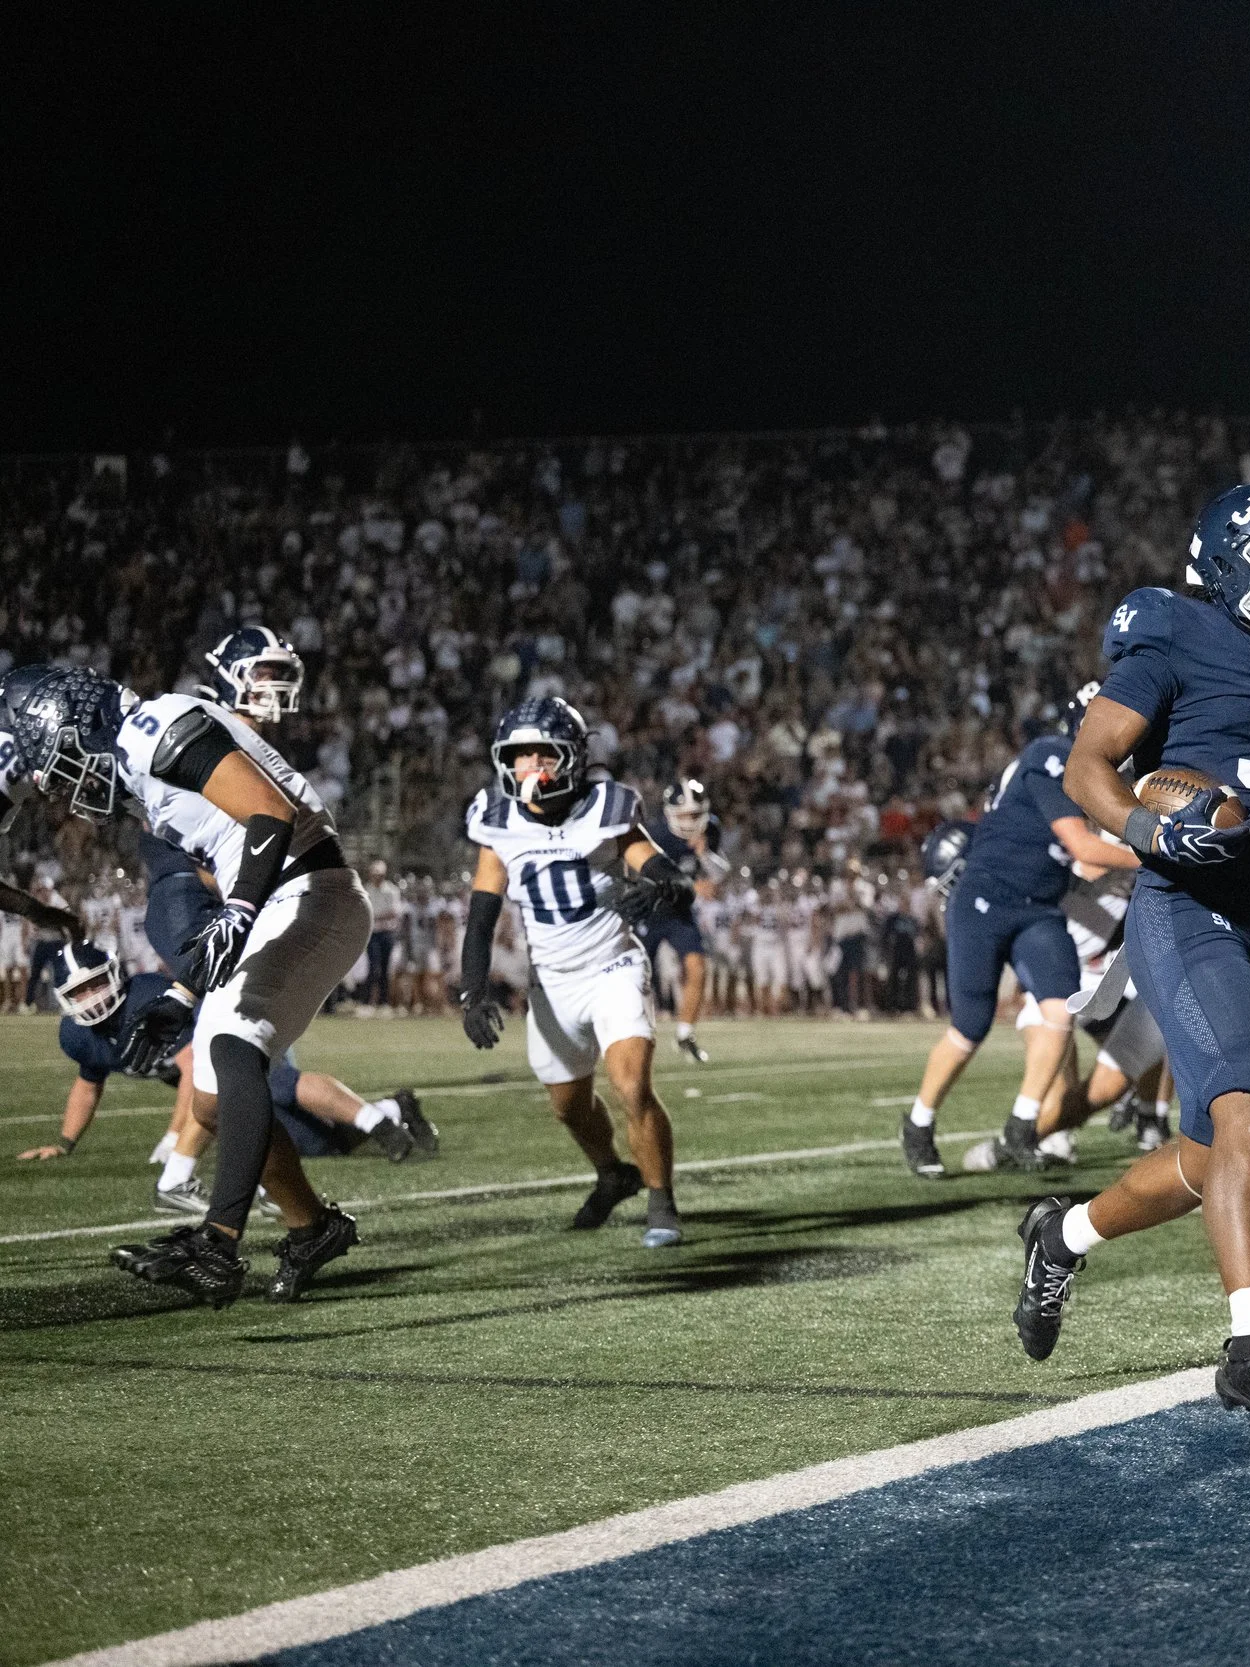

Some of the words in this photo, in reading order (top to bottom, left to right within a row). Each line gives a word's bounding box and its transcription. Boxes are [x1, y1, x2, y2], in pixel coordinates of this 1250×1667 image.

[1112, 603, 1138, 633] SV
[26, 696, 57, 719] 5
[131, 712, 160, 737] 5
[521, 858, 597, 925] 10
